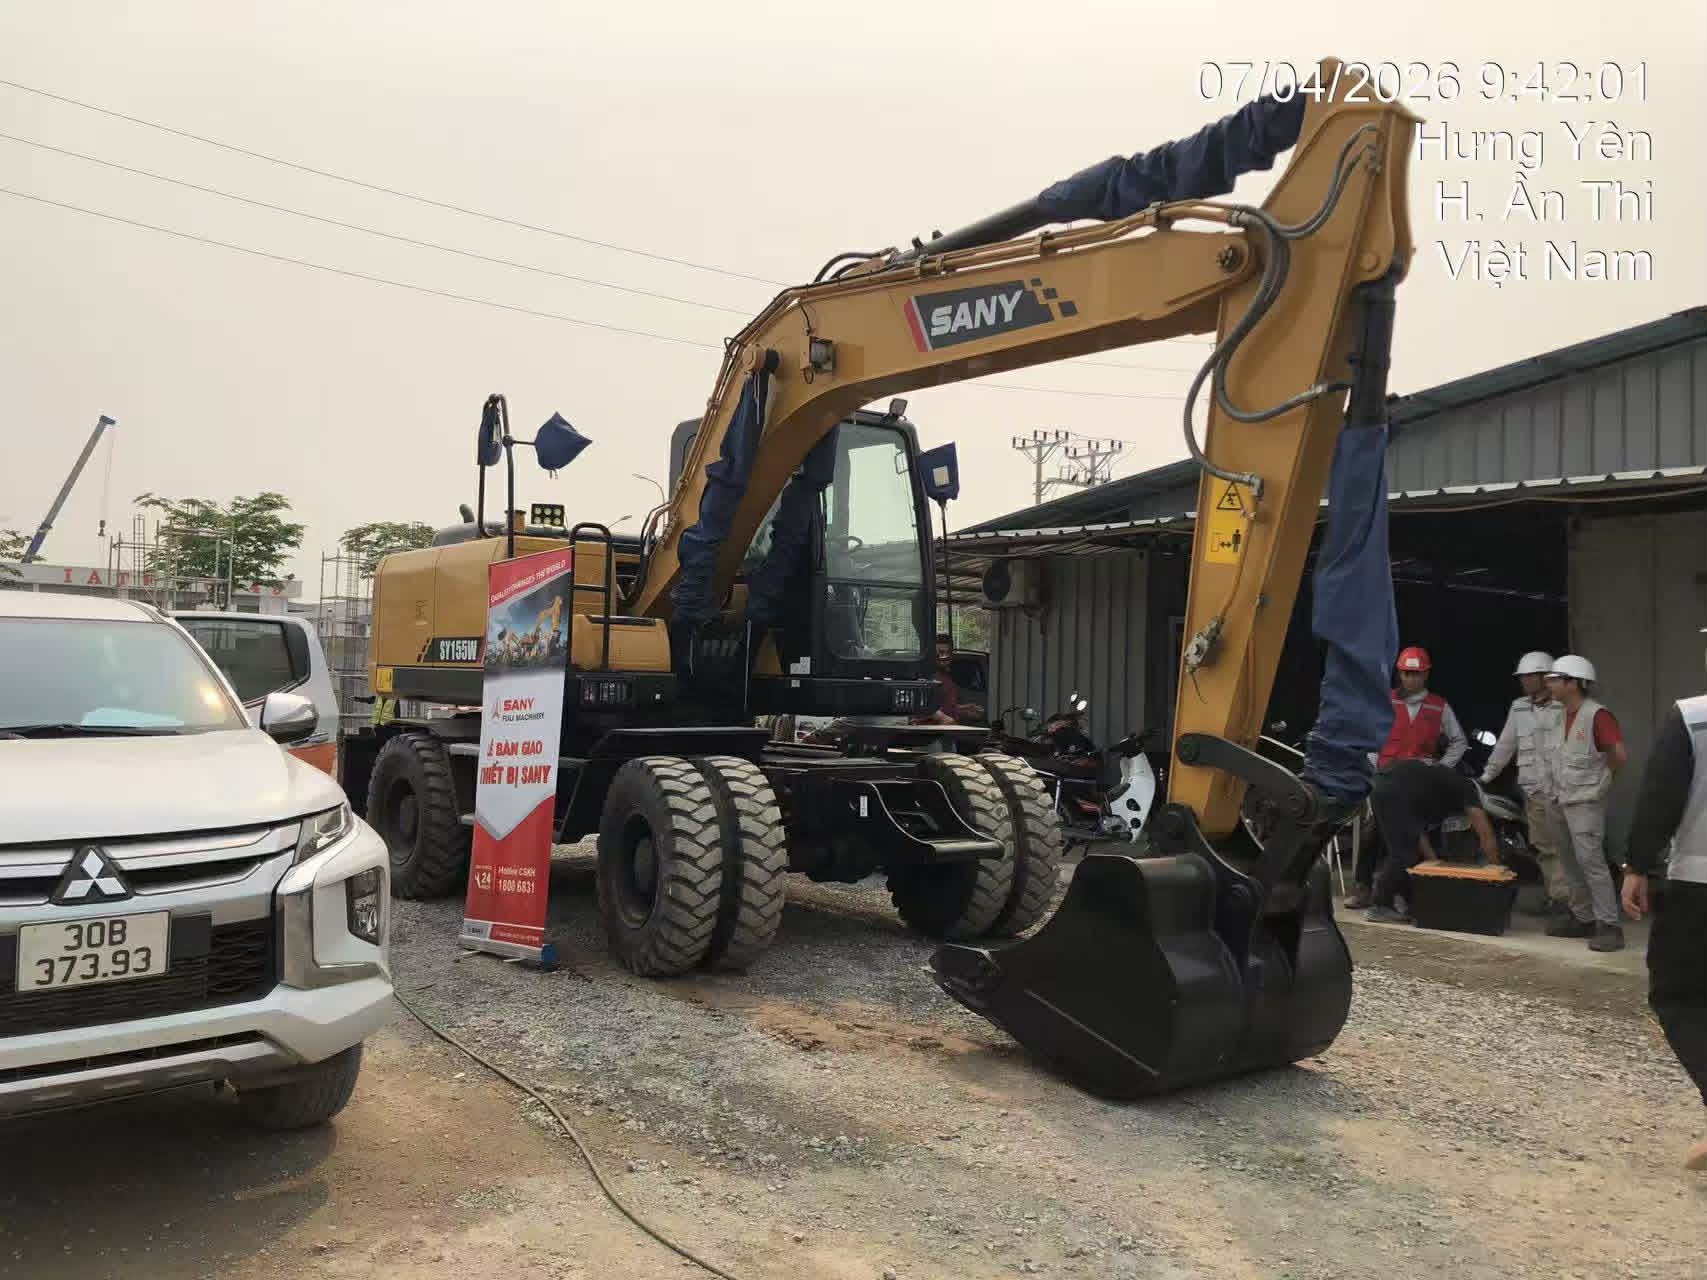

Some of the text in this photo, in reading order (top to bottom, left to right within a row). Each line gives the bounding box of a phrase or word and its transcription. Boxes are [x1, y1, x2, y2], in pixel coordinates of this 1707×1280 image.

[931, 289, 1023, 336] SANY
[440, 639, 477, 660] SY155W
[503, 697, 535, 712] SANY
[522, 740, 543, 756] GIAO
[521, 765, 551, 784] SANY
[63, 919, 127, 951] 30B
[35, 946, 151, 986] 373.93
